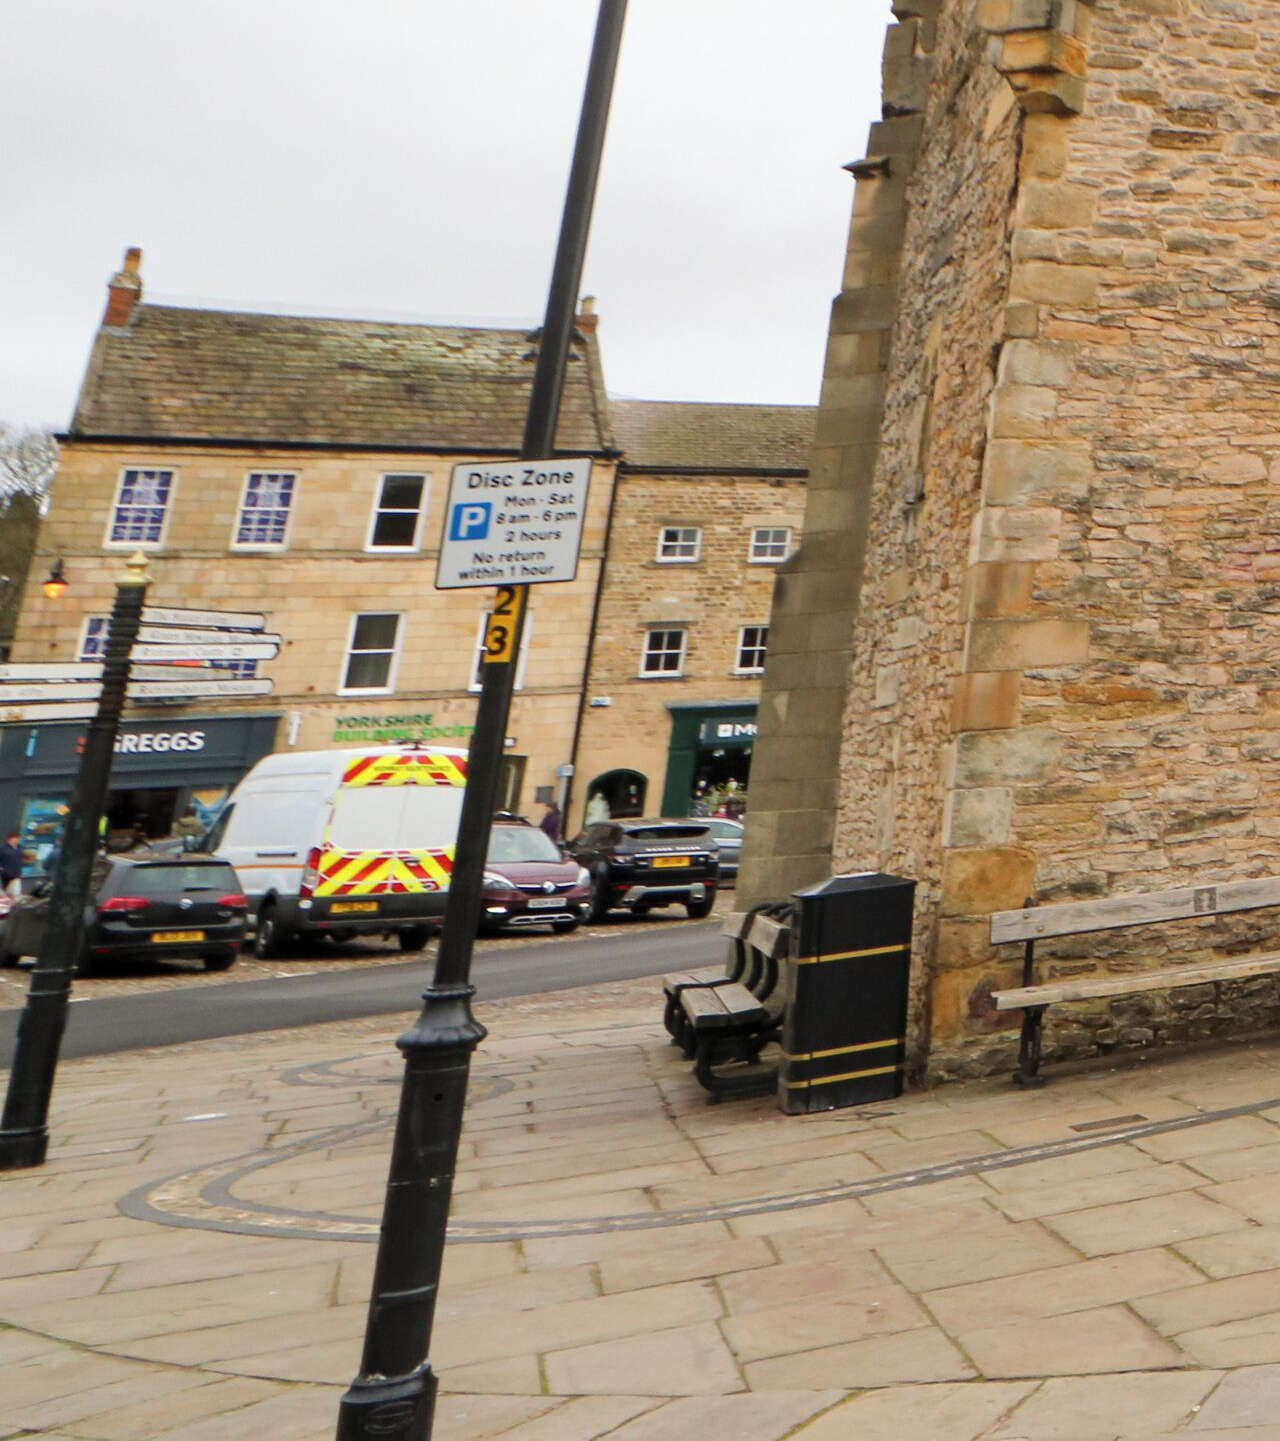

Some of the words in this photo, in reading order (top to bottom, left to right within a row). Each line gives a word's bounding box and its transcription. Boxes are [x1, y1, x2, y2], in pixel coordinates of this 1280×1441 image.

[467, 472, 513, 489] Disc
[521, 469, 574, 486] Zone
[505, 495, 536, 507] Mon
[548, 493, 574, 505] Sat
[458, 507, 486, 538] P
[505, 531, 515, 542] 2
[520, 530, 561, 542] hours
[472, 552, 494, 564] No
[499, 551, 546, 562] return
[458, 567, 504, 579] within
[521, 564, 554, 576] hour
[335, 714, 433, 729] YORKSHIRE
